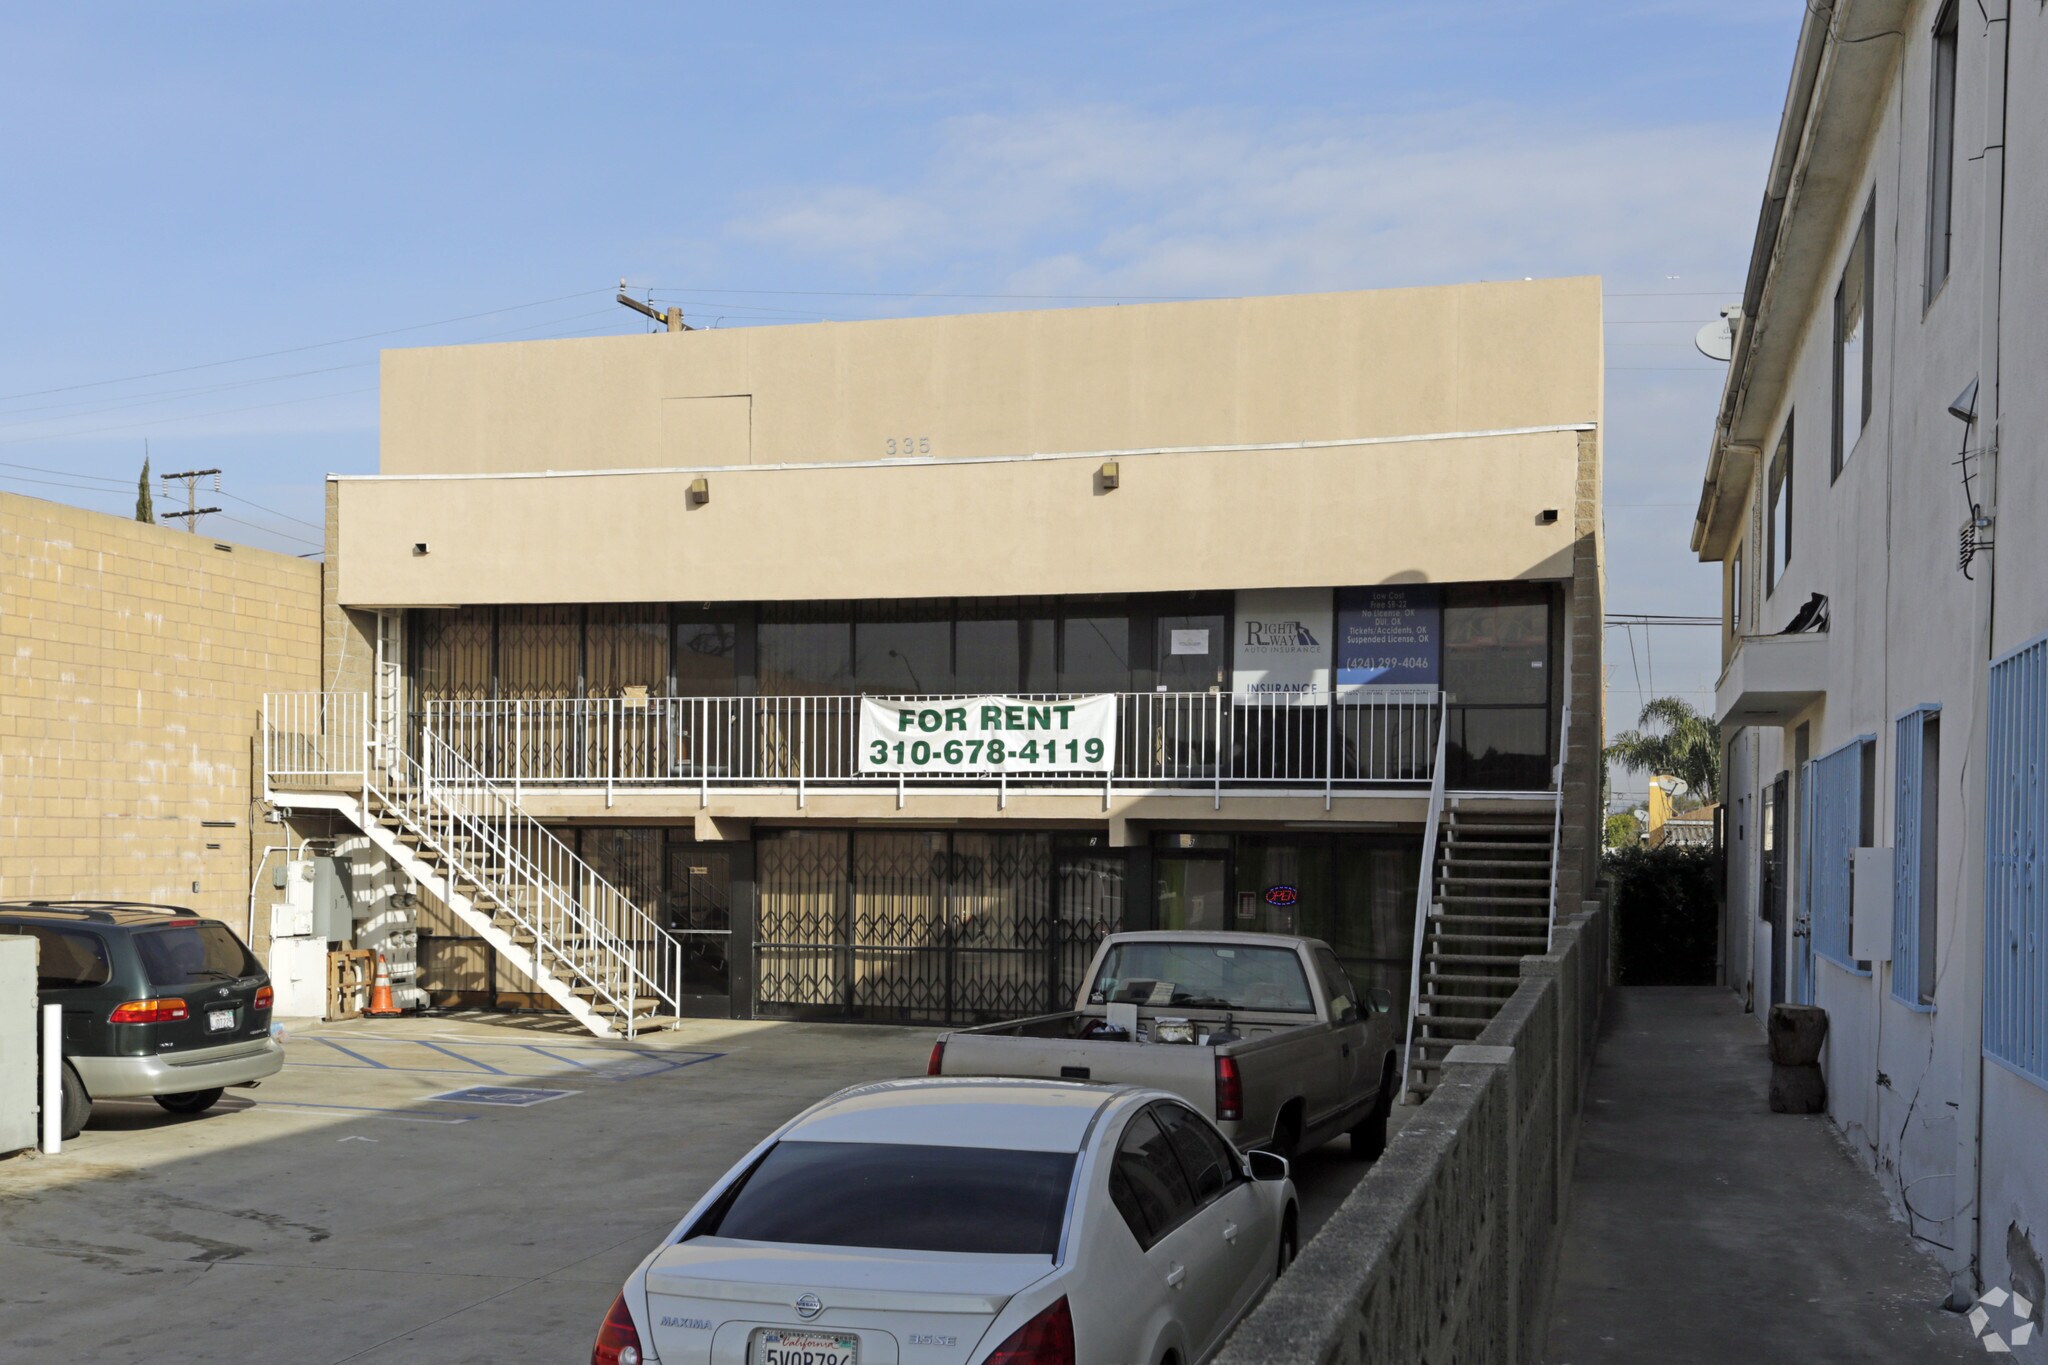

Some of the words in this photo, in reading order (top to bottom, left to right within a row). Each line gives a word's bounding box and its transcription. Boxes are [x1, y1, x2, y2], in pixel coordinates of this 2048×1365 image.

[886, 437, 930, 455] 335
[1416, 626, 1427, 634] OK
[1269, 635, 1297, 646] WAY
[1347, 635, 1386, 644] Suspended
[1346, 658, 1375, 672] (424)
[1378, 657, 1428, 669] 299-4046
[1247, 683, 1317, 695] INSURANCE
[898, 708, 967, 733] FOR
[980, 705, 1076, 731] RENT
[869, 737, 1105, 765] 310-678-4119
[1265, 890, 1297, 901] OPEN
[660, 1316, 712, 1330] MAXIMA
[782, 1336, 839, 1351] California
